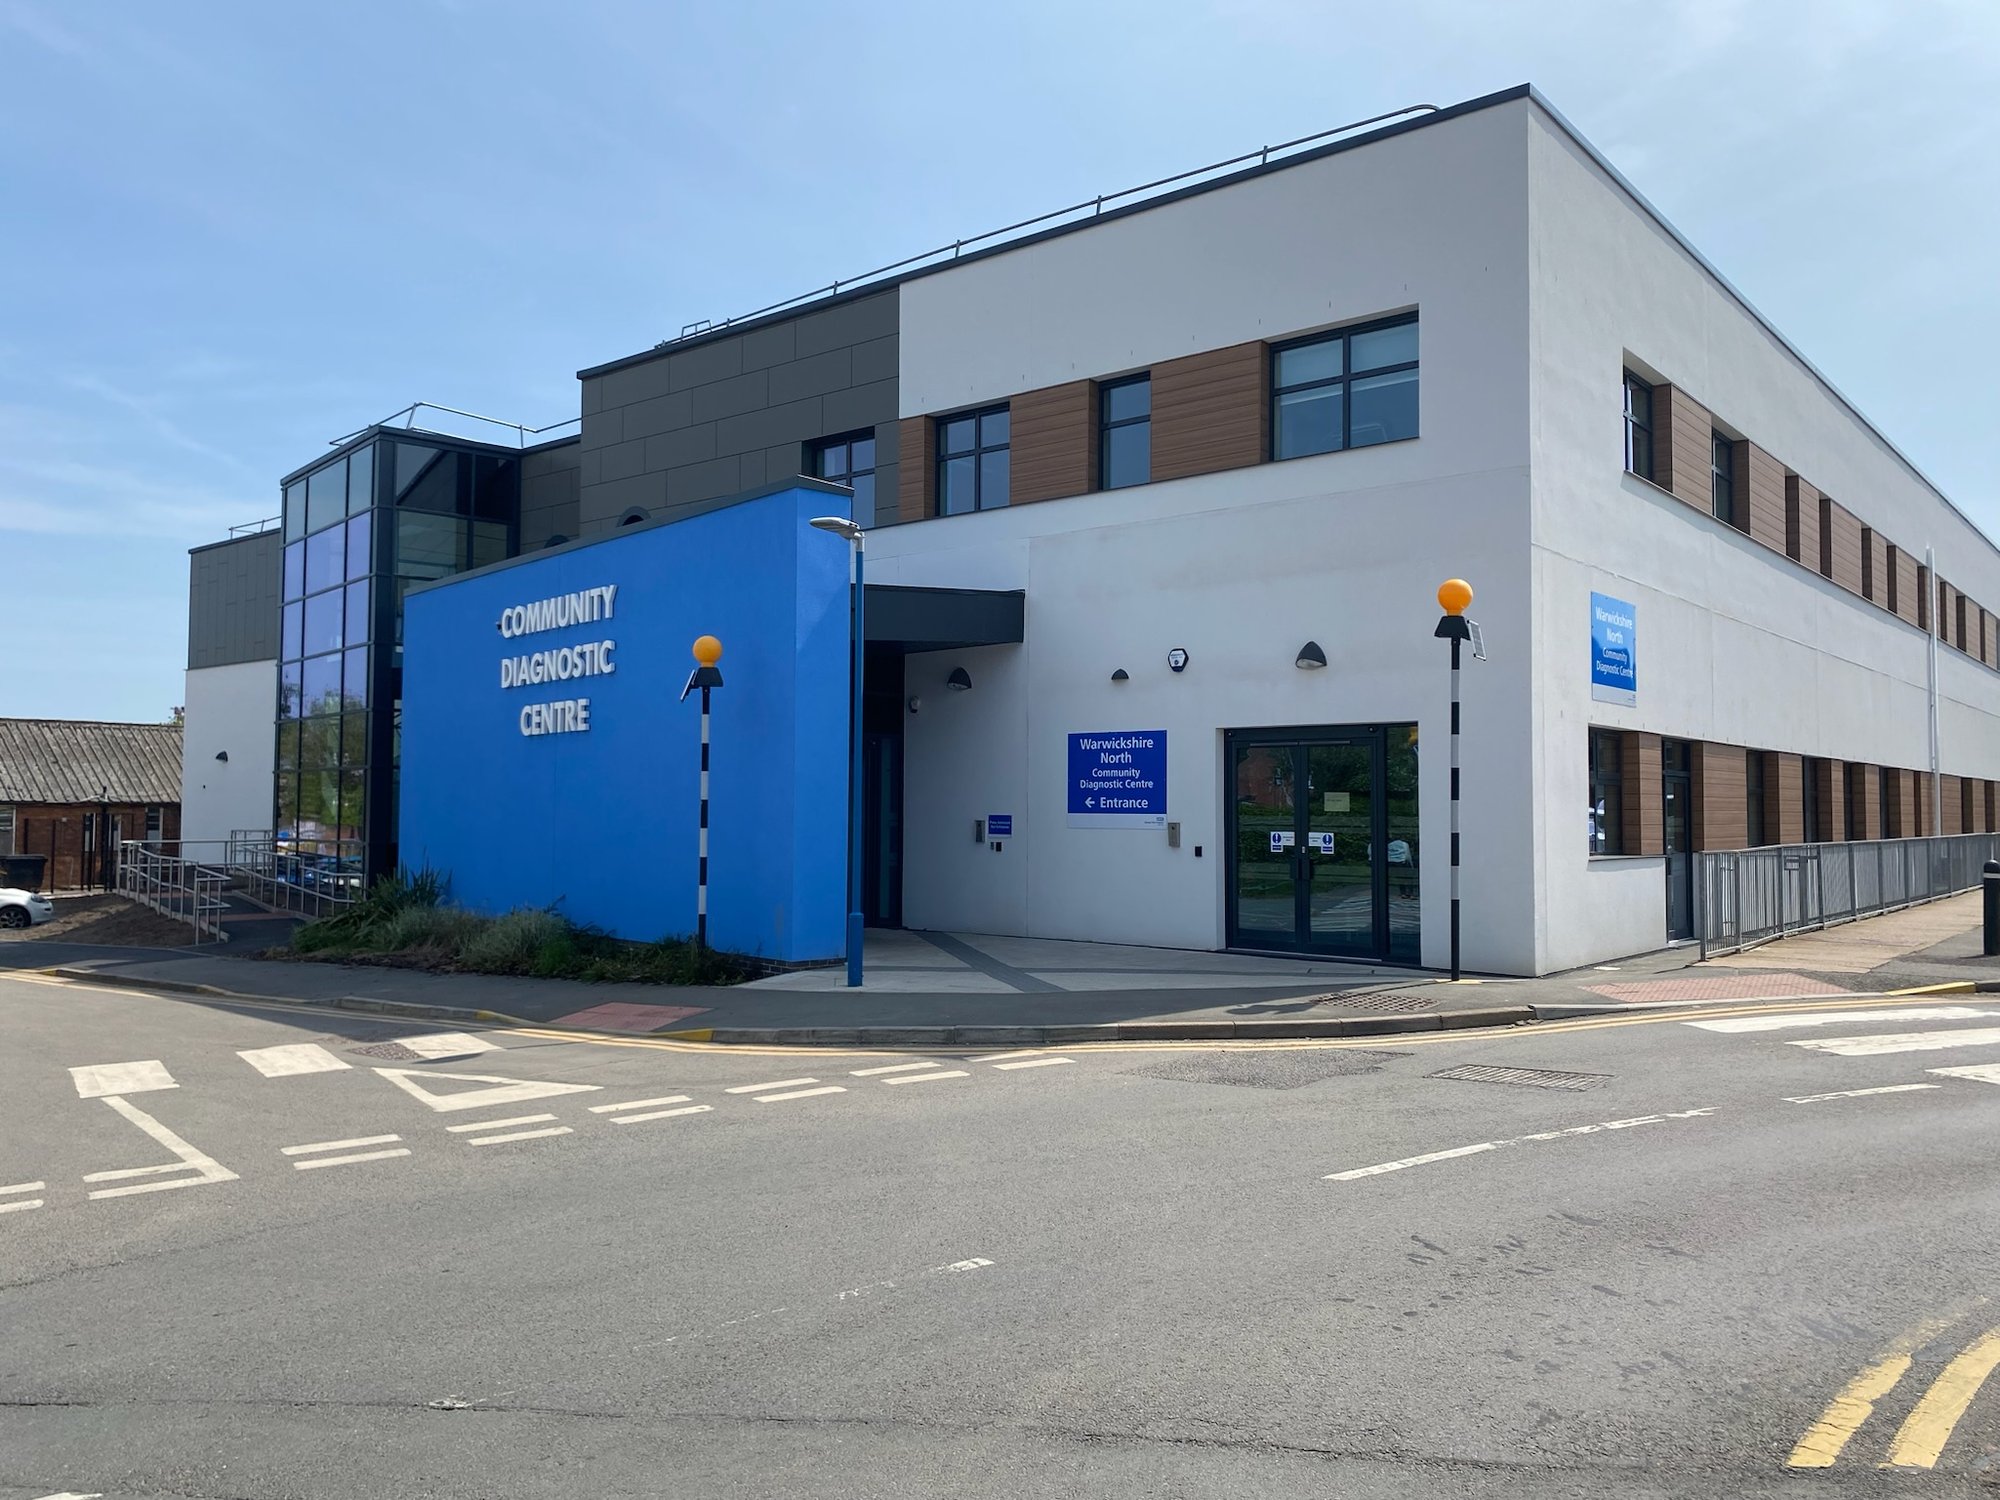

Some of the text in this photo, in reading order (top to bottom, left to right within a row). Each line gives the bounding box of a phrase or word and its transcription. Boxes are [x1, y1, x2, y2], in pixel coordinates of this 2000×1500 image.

[501, 584, 617, 638] COMMUNITY
[1596, 606, 1632, 630] Warwickshire
[1606, 628, 1624, 644] North
[1603, 647, 1628, 664] Community
[501, 640, 616, 689] DIAGNOSTIC
[1596, 660, 1620, 675] Diagnostic
[520, 698, 590, 736] CENTRE
[1080, 736, 1154, 750] Warwickshire
[1100, 751, 1132, 764] North
[1092, 767, 1140, 778] Community
[1080, 779, 1154, 790] Diagnostic Centre
[1100, 796, 1148, 808] Entrance
